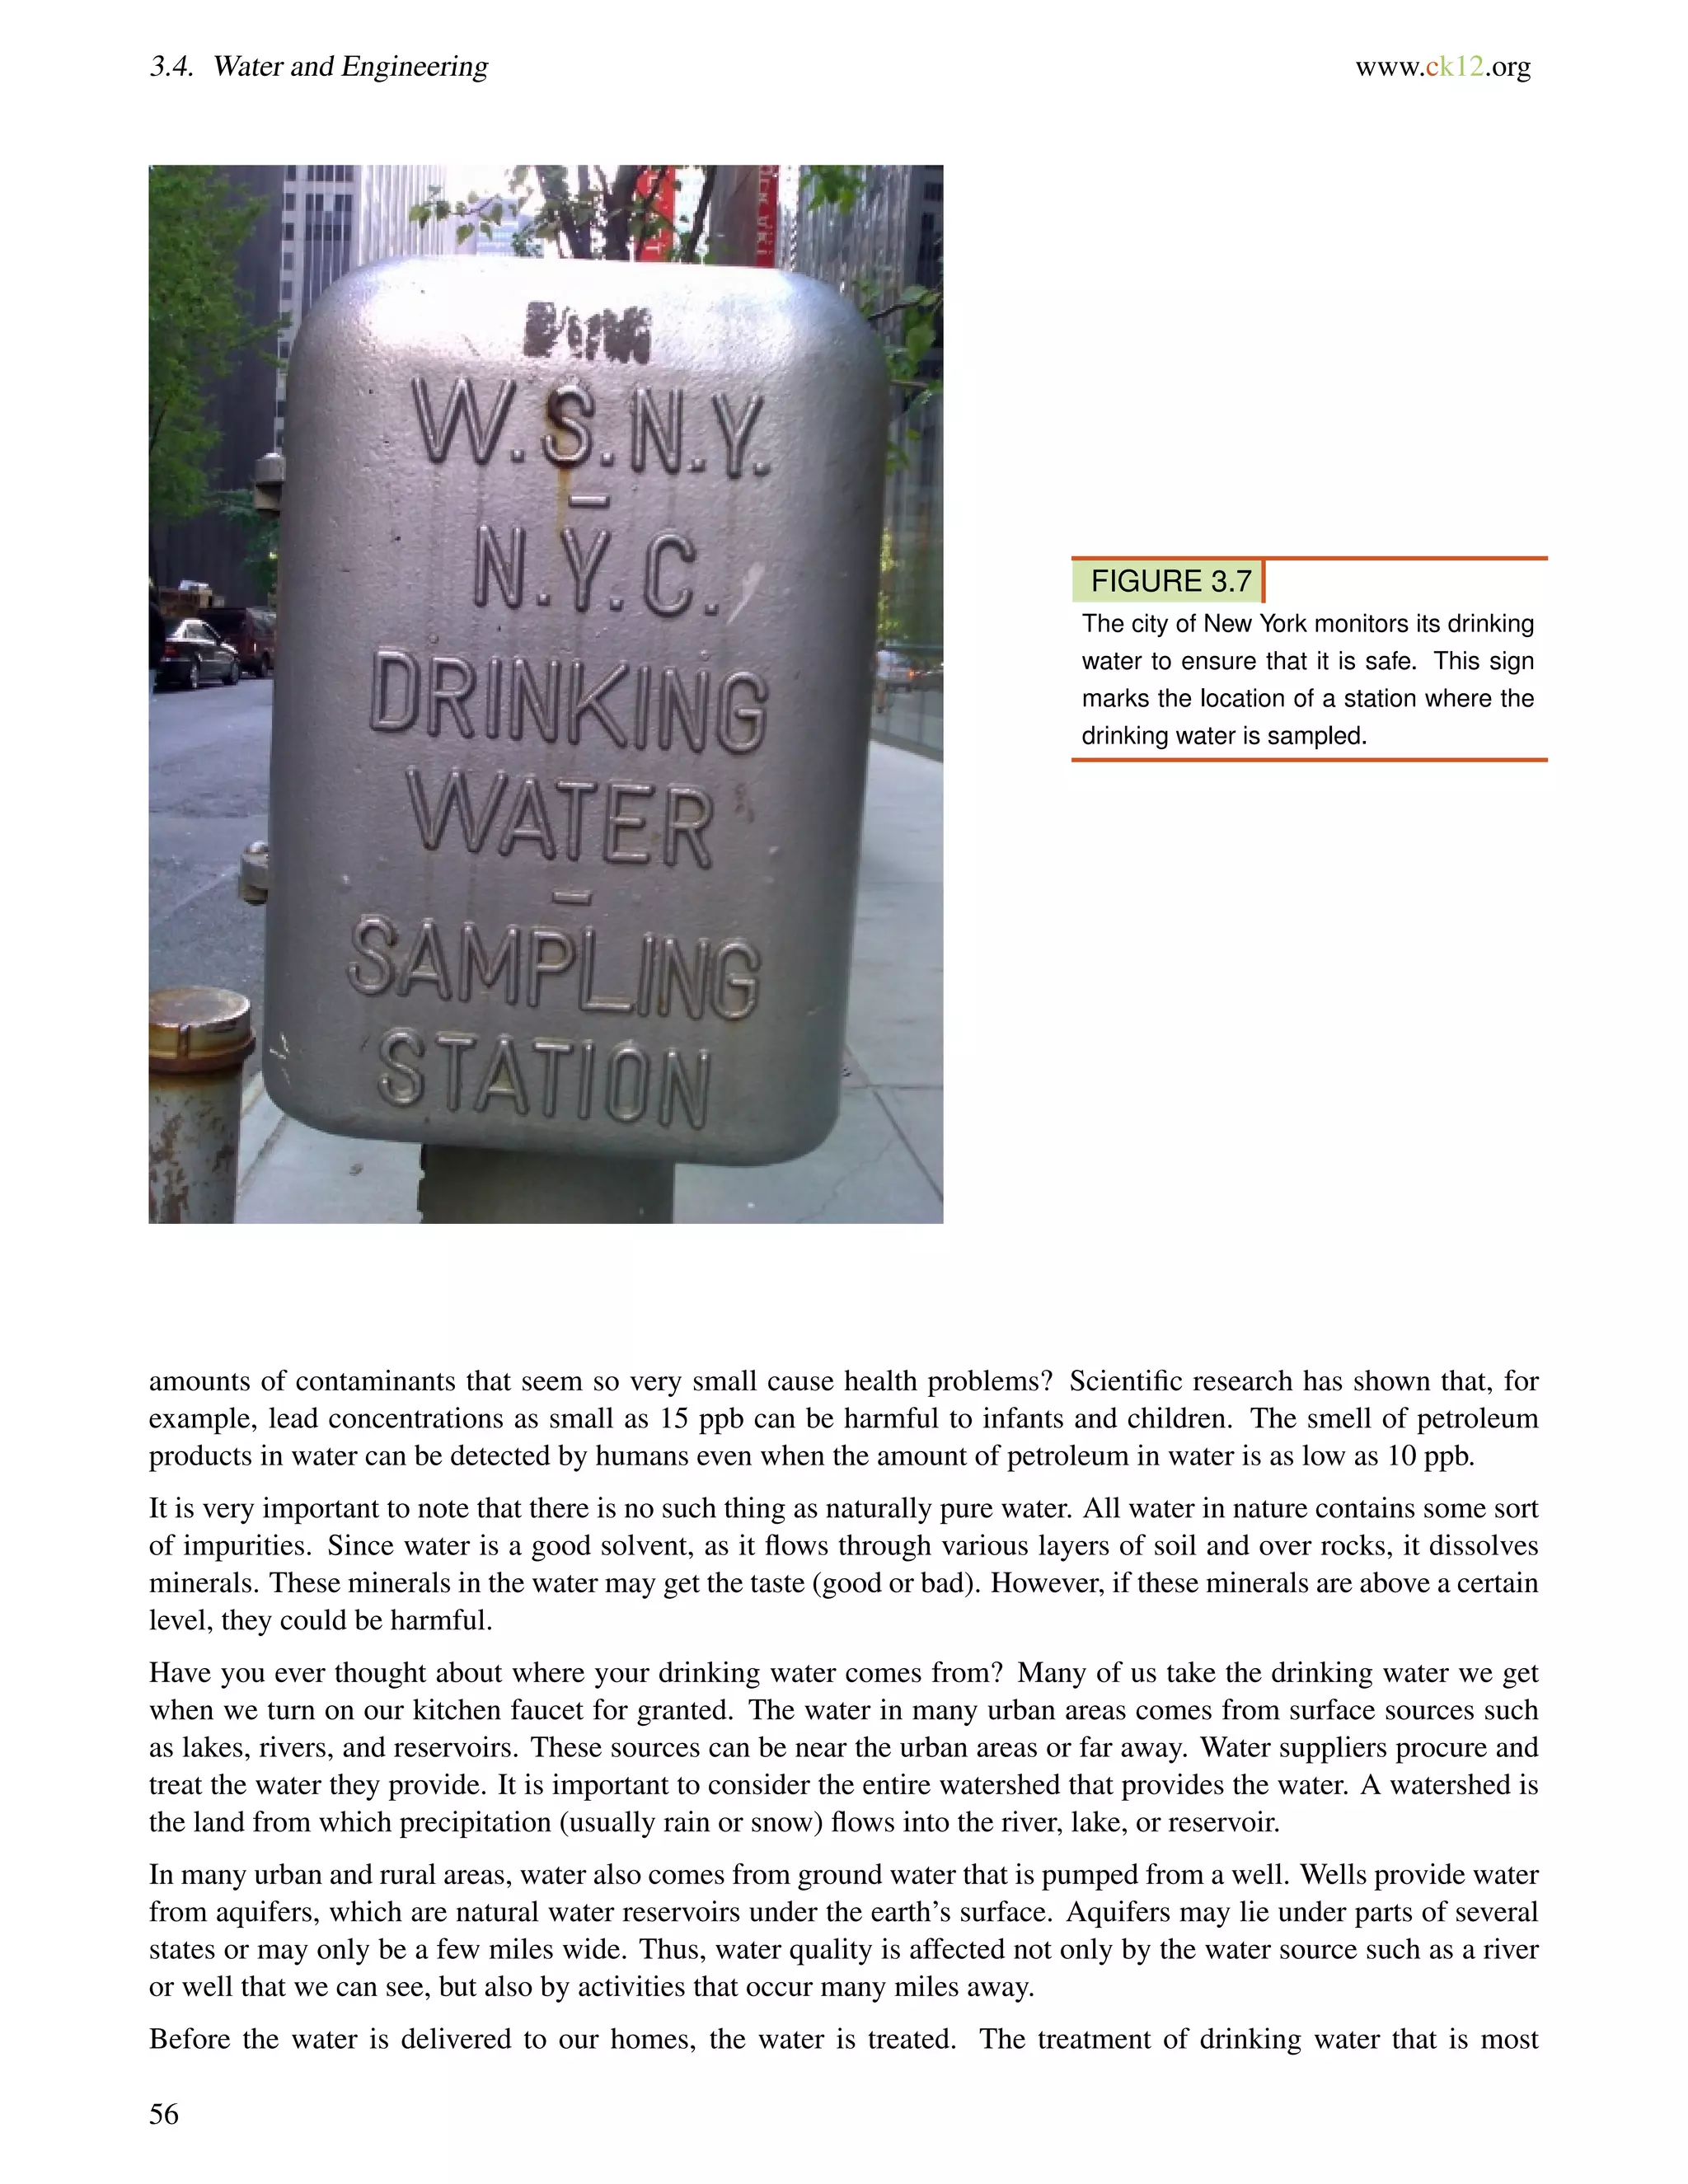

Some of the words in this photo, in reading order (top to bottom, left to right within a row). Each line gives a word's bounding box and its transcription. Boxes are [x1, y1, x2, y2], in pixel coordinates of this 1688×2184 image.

[149, 54, 193, 77] 3.4.
[213, 54, 285, 77] Water
[290, 54, 335, 77] and
[340, 54, 490, 83] Engineering
[1355, 54, 1531, 83] www.ck12.org
[410, 376, 771, 480] W.S.N.Y.
[473, 523, 720, 618] N.Y.C.
[1092, 568, 1203, 593] FIGURE
[1211, 569, 1253, 593] 3.7
[1081, 613, 1124, 633] The
[1132, 613, 1169, 638] city
[1175, 612, 1197, 633] of
[1204, 613, 1253, 633] New
[1259, 613, 1308, 633] York
[1315, 612, 1409, 633] monitors
[1417, 613, 1441, 633] its
[1447, 613, 1534, 638] drinking
[1081, 652, 1143, 671] water
[1151, 652, 1172, 671] to
[1181, 655, 1257, 671] ensure
[1265, 650, 1308, 671] that
[1317, 650, 1329, 671] it
[1339, 650, 1356, 671] is
[1366, 650, 1417, 671] safe.
[1433, 650, 1480, 671] This
[1489, 650, 1534, 676] sign
[368, 645, 770, 756] DRINKING
[1083, 687, 1150, 708] marks
[1157, 687, 1192, 708] the
[1201, 687, 1285, 708] location
[1293, 687, 1315, 708] of
[1322, 692, 1336, 708] a
[1344, 687, 1416, 708] station
[1424, 687, 1492, 708] where
[1500, 687, 1535, 708] the
[1081, 725, 1168, 750] drinking
[1175, 726, 1236, 745] water
[1244, 725, 1260, 745] is
[1268, 724, 1367, 750] sampled.
[404, 764, 715, 870] WATER
[345, 912, 762, 1021] SAMPLING
[377, 1026, 712, 1131] STATION
[148, 1444, 252, 1473] products
[260, 1444, 284, 1466] in
[291, 1447, 359, 1466] water
[365, 1451, 407, 1466] can
[414, 1444, 443, 1466] be
[450, 1444, 551, 1466] detected
[557, 1444, 588, 1473] by
[595, 1444, 689, 1466] humans
[696, 1451, 753, 1466] even
[760, 1444, 825, 1466] when
[832, 1444, 870, 1466] the
[877, 1447, 968, 1466] amount
[975, 1444, 1002, 1466] of
[1007, 1444, 1130, 1473] petroleum
[1137, 1444, 1160, 1466] in
[1168, 1447, 1236, 1466] water
[1242, 1444, 1262, 1466] is
[1269, 1451, 1294, 1466] as
[1301, 1444, 1346, 1466] low
[1354, 1451, 1379, 1466] as
[1390, 1444, 1417, 1466] 10
[1423, 1444, 1475, 1473] ppb.
[149, 1533, 176, 1556] of
[183, 1533, 312, 1563] impurities.
[328, 1534, 394, 1556] Since
[403, 1537, 471, 1556] water
[479, 1534, 499, 1556] is
[509, 1540, 523, 1556] a
[531, 1534, 592, 1563] good
[601, 1534, 694, 1559] solvent,
[705, 1540, 729, 1556] as
[738, 1533, 756, 1556] it
[765, 1533, 828, 1556] flows
[838, 1534, 932, 1563] through
[941, 1534, 1029, 1556] various
[1038, 1534, 1109, 1563] layers
[1119, 1533, 1146, 1556] of
[1154, 1533, 1197, 1556] soil
[1207, 1534, 1250, 1556] and
[1259, 1540, 1313, 1556] over
[1320, 1534, 1393, 1560] rocks,
[1403, 1534, 1421, 1556] it
[1429, 1534, 1539, 1556] dissolves
[149, 1742, 174, 1758] as
[182, 1736, 251, 1761] lakes,
[259, 1735, 334, 1762] rivers,
[343, 1736, 387, 1758] and
[393, 1735, 518, 1758] reservoirs.
[530, 1736, 603, 1758] These
[611, 1741, 701, 1758] sources
[709, 1742, 751, 1758] can
[757, 1736, 787, 1758] be
[795, 1742, 847, 1758] near
[855, 1736, 892, 1758] the
[899, 1736, 968, 1758] urban
[977, 1742, 1038, 1758] areas
[1046, 1741, 1072, 1758] or
[1079, 1735, 1114, 1758] far
[1121, 1741, 1188, 1765] away.
[1199, 1736, 1272, 1758] Water
[1279, 1735, 1387, 1765] suppliers
[1395, 1742, 1488, 1765] procure
[1496, 1736, 1540, 1758] and
[149, 1941, 215, 1960] states
[224, 1943, 250, 1960] or
[257, 1943, 309, 1966] may
[316, 1938, 370, 1966] only
[377, 1938, 407, 1960] be
[415, 1943, 429, 1960] a
[436, 1937, 481, 1960] few
[489, 1937, 554, 1960] miles
[562, 1937, 627, 1960] wide.
[639, 1938, 706, 1964] Thus,
[715, 1941, 782, 1960] water
[790, 1937, 873, 1966] quality
[881, 1937, 901, 1960] is
[909, 1937, 1006, 1960] affected
[1013, 1941, 1053, 1960] not
[1060, 1938, 1114, 1966] only
[1121, 1938, 1151, 1966] by
[1160, 1938, 1197, 1960] the
[1204, 1941, 1272, 1960] water
[1280, 1943, 1357, 1960] source
[1367, 1938, 1421, 1960] such
[1429, 1943, 1454, 1960] as
[1462, 1944, 1476, 1960] a
[1483, 1937, 1540, 1960] river
[148, 2027, 231, 2050] Before
[242, 2027, 279, 2050] the
[291, 2031, 359, 2050] water
[369, 2027, 389, 2050] is
[401, 2027, 513, 2050] delivered
[523, 2031, 547, 2050] to
[559, 2033, 600, 2050] our
[610, 2027, 696, 2053] homes,
[709, 2027, 746, 2050] the
[757, 2031, 825, 2050] water
[837, 2027, 856, 2050] is
[868, 2027, 956, 2050] treated.
[979, 2027, 1026, 2050] The
[1038, 2030, 1152, 2050] treatment
[1163, 2027, 1191, 2050] of
[1200, 2027, 1302, 2055] drinking
[1314, 2031, 1381, 2050] water
[1391, 2027, 1437, 2050] that
[1449, 2027, 1469, 2050] is
[1480, 2031, 1540, 2050] most
[149, 2102, 179, 2125] 56
